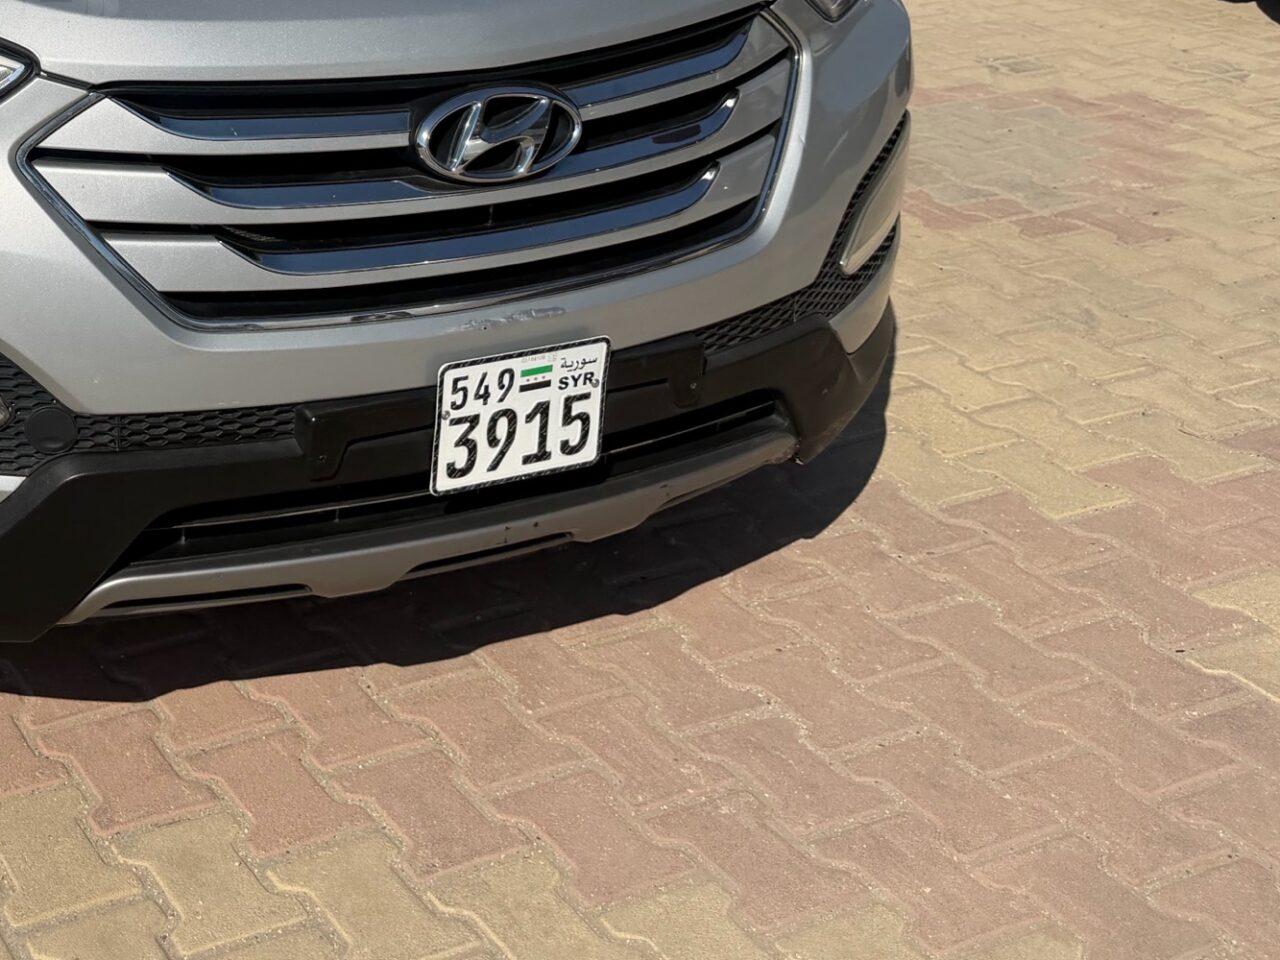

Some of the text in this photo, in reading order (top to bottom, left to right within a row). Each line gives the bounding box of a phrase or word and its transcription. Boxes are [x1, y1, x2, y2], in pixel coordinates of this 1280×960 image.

[560, 357, 598, 372] سورية
[450, 368, 515, 411] 549
[558, 371, 595, 390] SYR
[446, 392, 592, 479] 3915
